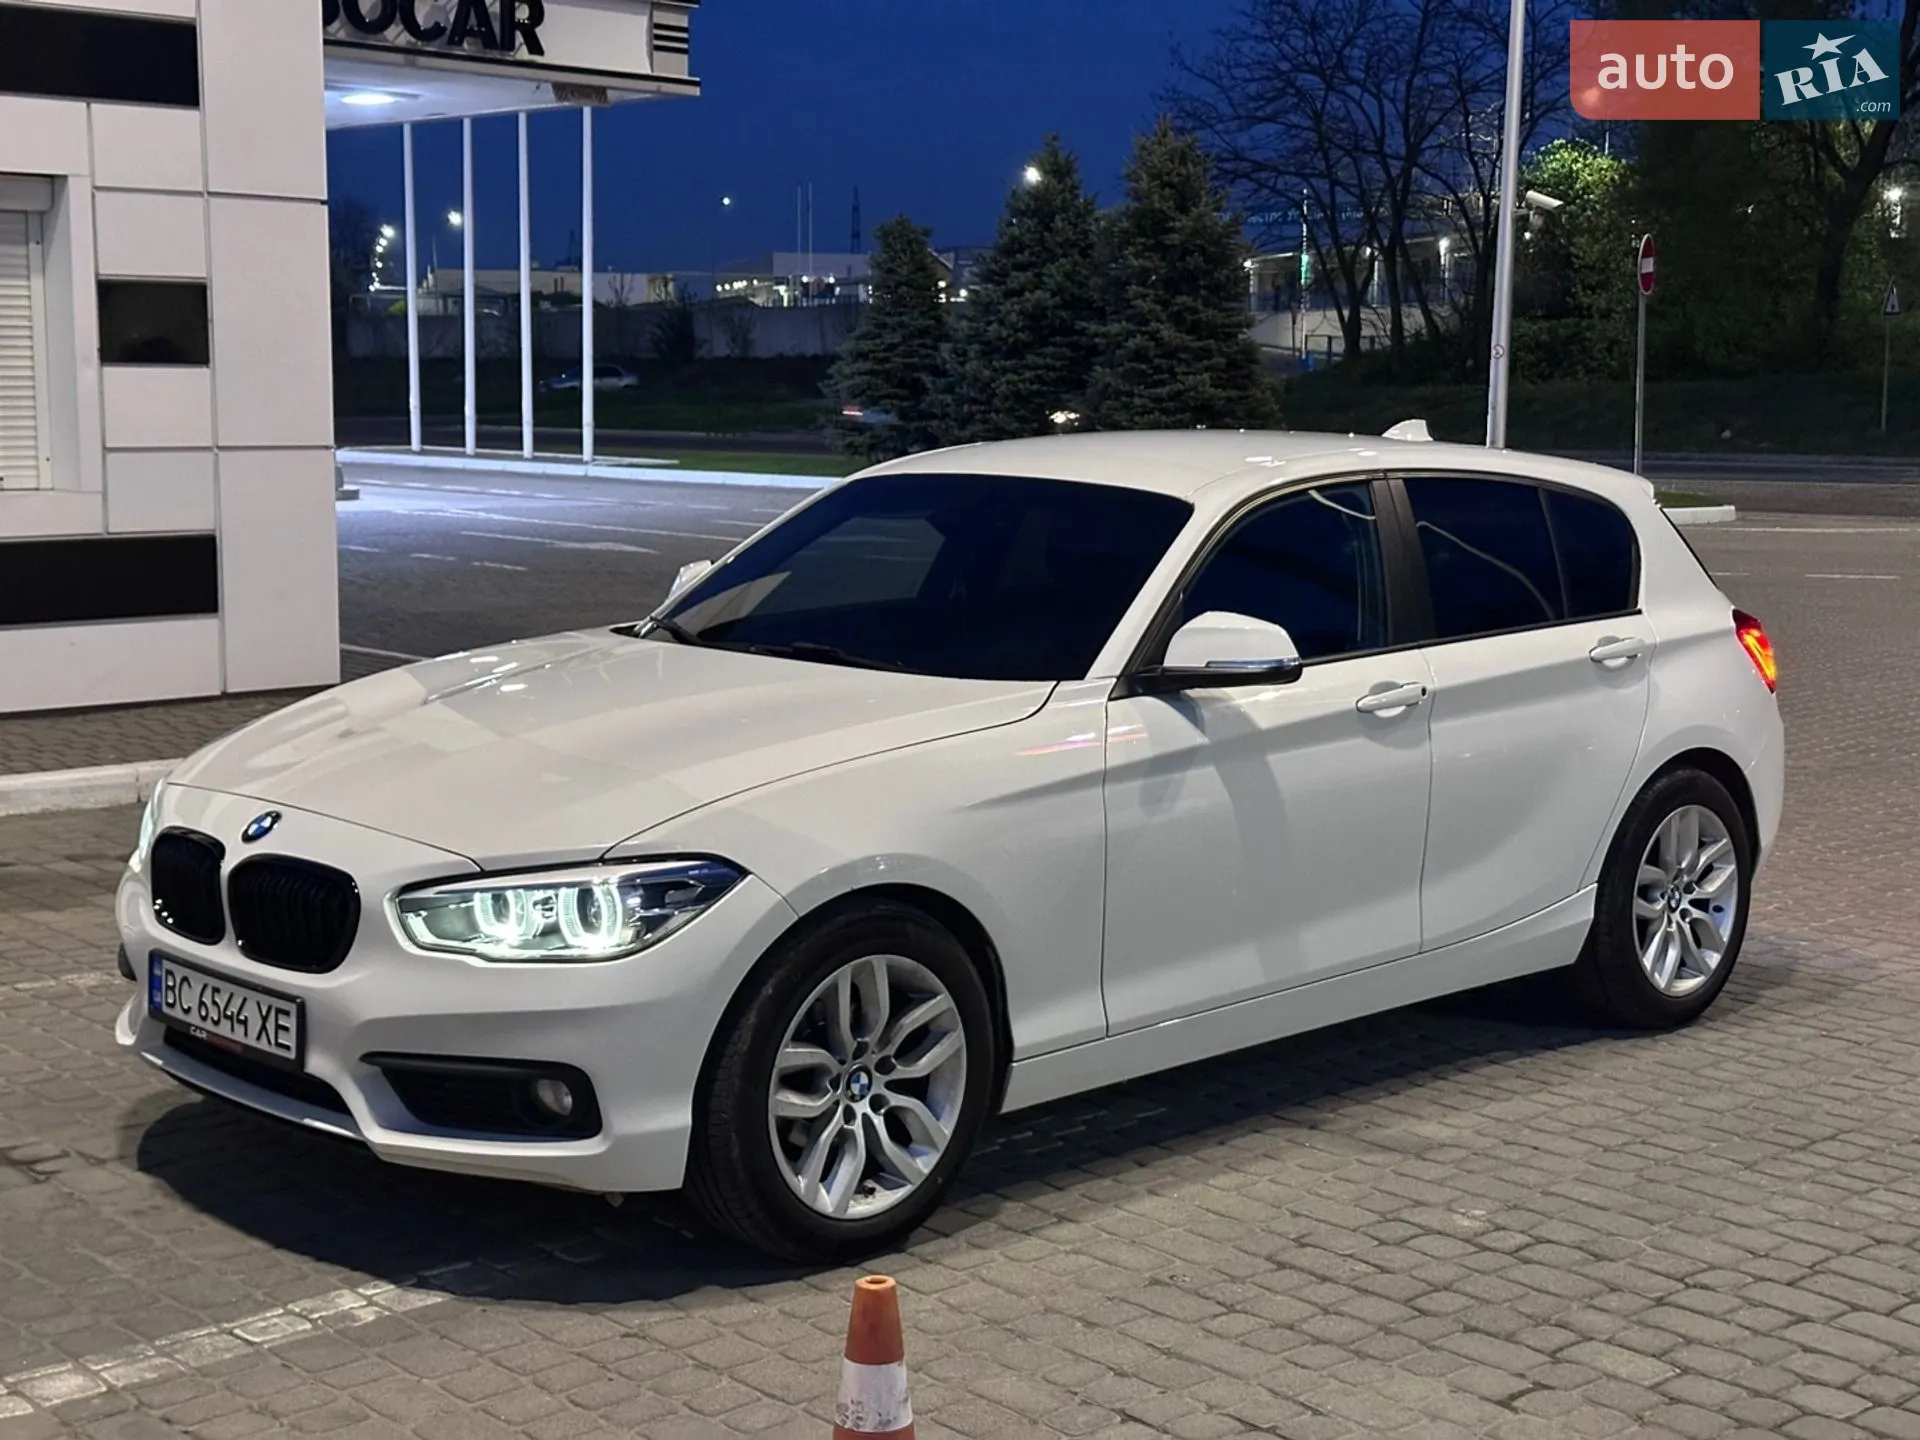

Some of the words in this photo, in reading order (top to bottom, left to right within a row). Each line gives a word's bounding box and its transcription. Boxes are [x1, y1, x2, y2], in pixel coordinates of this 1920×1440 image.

[165, 968, 192, 1014] BC
[198, 983, 249, 1038] 6544
[256, 1000, 292, 1051] XE
